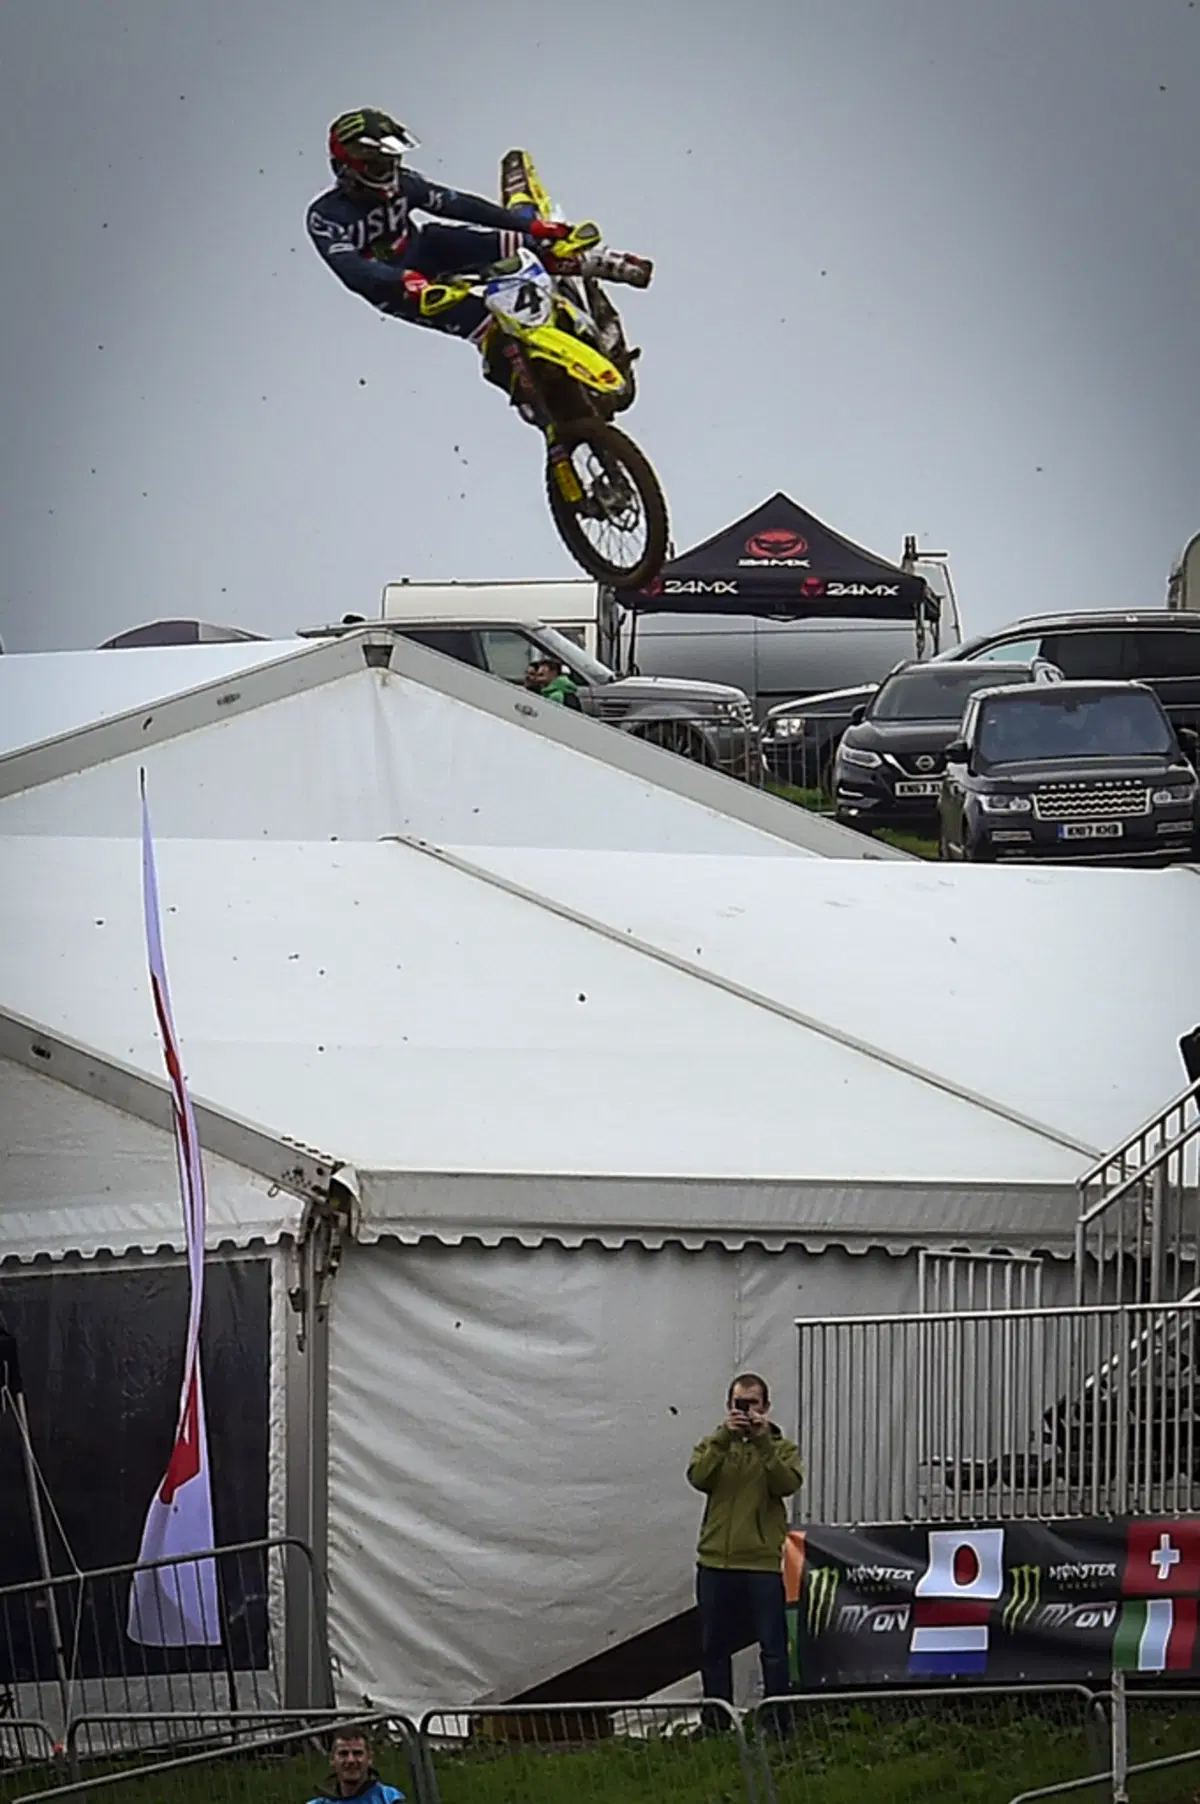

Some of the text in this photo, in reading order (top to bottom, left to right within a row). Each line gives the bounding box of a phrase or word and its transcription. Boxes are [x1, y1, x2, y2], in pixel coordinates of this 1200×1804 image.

[513, 283, 543, 314] 4
[664, 580, 739, 595] 24MX
[826, 582, 900, 597] 24MX
[846, 1565, 915, 1582] MONSTER
[1049, 1562, 1117, 1581] MONSTER
